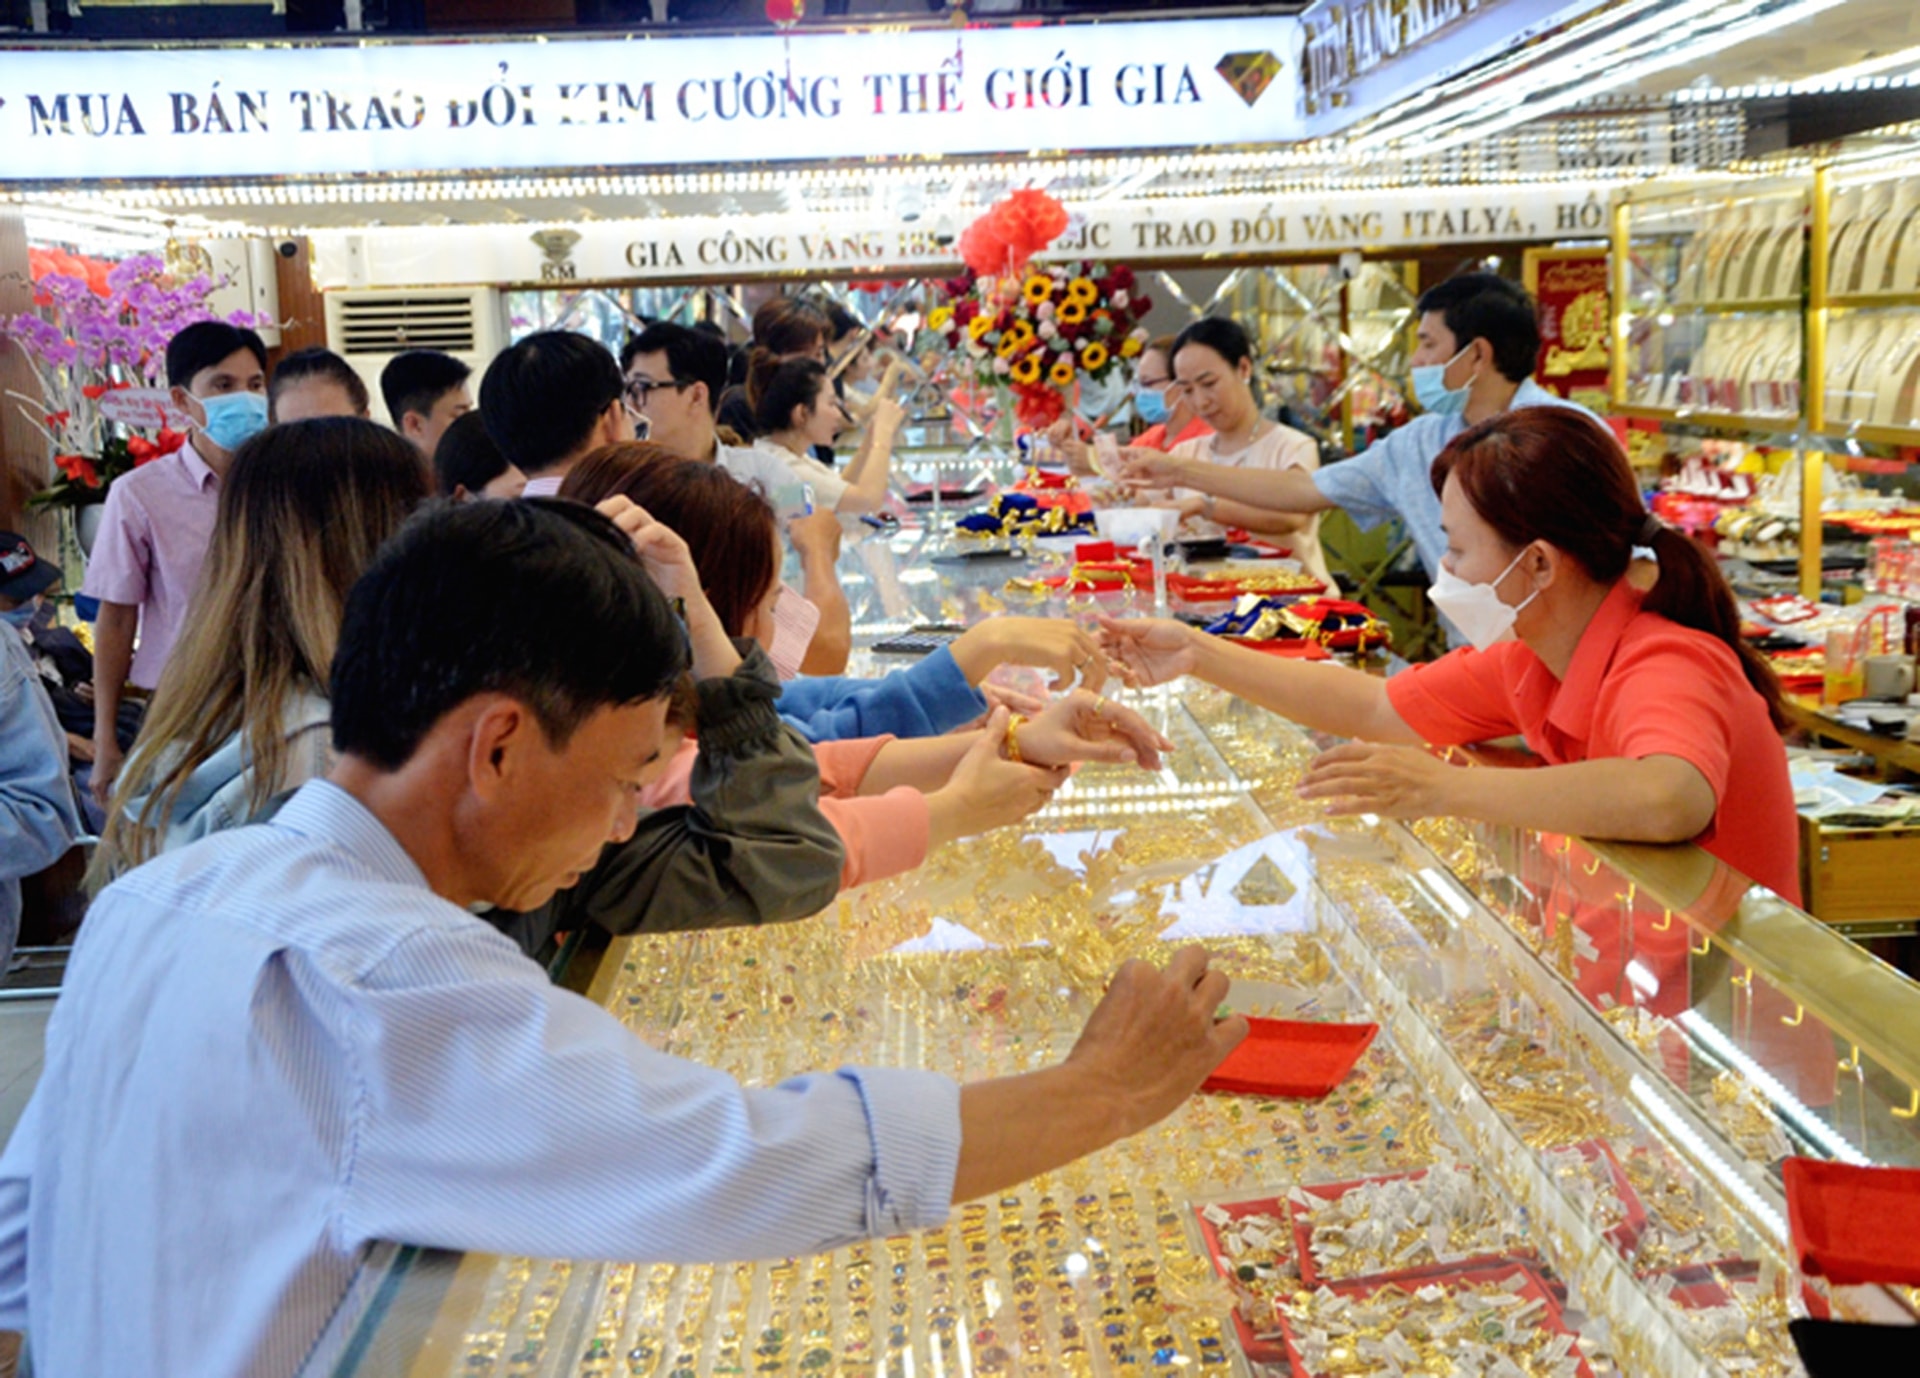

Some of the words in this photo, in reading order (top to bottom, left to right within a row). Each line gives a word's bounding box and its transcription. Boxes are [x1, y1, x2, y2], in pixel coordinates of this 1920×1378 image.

[24, 92, 147, 138] MUA
[167, 79, 269, 135] BÁN
[289, 90, 426, 132] TRAO
[557, 81, 656, 125] KIM
[677, 69, 842, 122] CƯƠNG
[863, 47, 965, 115] THẾ
[985, 49, 1092, 111] GIỚI
[1114, 63, 1204, 107] GIA
[625, 240, 684, 269] GIA
[697, 229, 788, 266] CÔNG
[798, 225, 885, 262] VÀNG
[1132, 215, 1218, 248] TRAO
[1302, 206, 1384, 242] VÀNG
